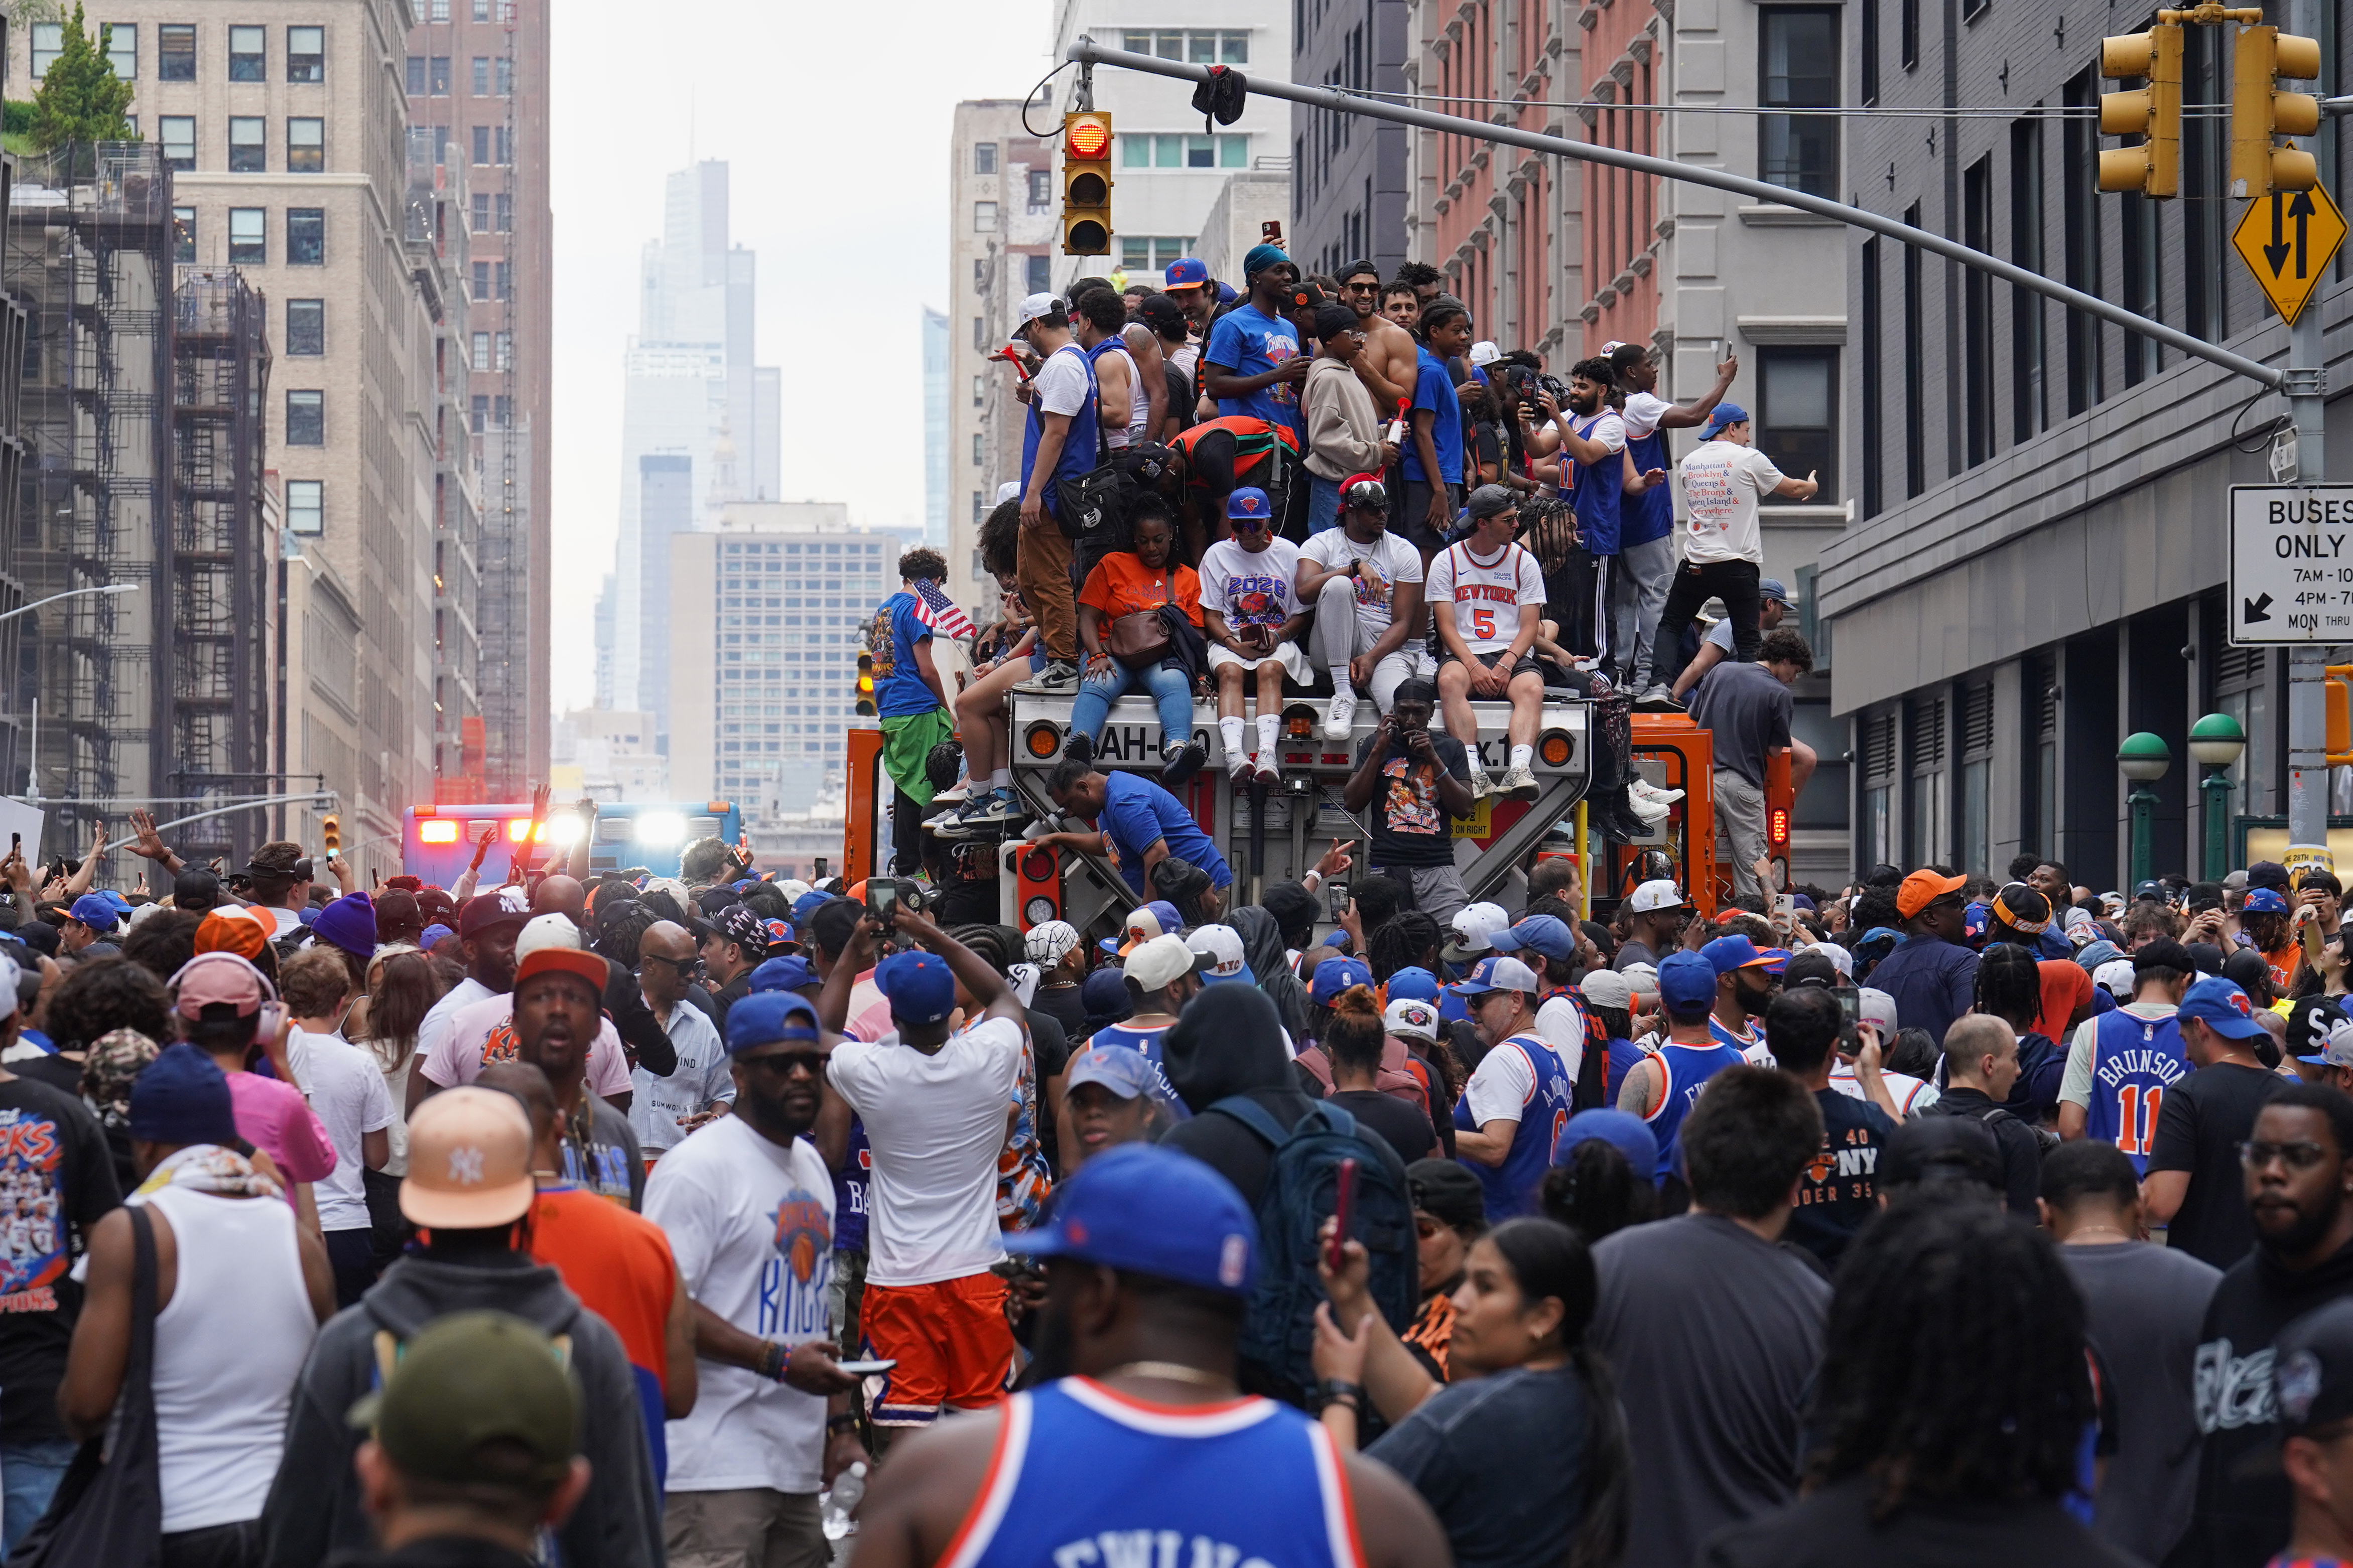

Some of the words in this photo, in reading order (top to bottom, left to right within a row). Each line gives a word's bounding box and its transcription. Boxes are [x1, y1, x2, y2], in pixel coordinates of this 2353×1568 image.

[1559, 459, 1575, 490] 11
[1685, 463, 1725, 471] Manhattan
[1688, 471, 1724, 479] Brooklyn
[1692, 480, 1719, 488] Queens
[1689, 490, 1701, 498] The
[1702, 489, 1726, 497] Bronx
[1707, 497, 1731, 506] Island
[1086, 510, 1097, 525] MTA
[2269, 500, 2353, 524] BUSES
[2276, 534, 2346, 558] ONLY
[2293, 568, 2323, 583] 7AM
[1228, 577, 1287, 600] 2026
[1455, 584, 1481, 604] NEW
[1481, 584, 1517, 606] YORK
[2295, 591, 2326, 606] 4PM
[1474, 609, 1496, 640] 5
[2289, 614, 2318, 629] MON
[2326, 616, 2350, 626] THRU
[1456, 825, 1465, 834] ON
[1467, 825, 1487, 834] RIGHT
[1216, 959, 1239, 974] NYC
[2115, 1083, 2164, 1156] 11
[1846, 1128, 1869, 1146] 40
[1837, 1147, 1878, 1177] NY
[1852, 1181, 1872, 1199] 35
